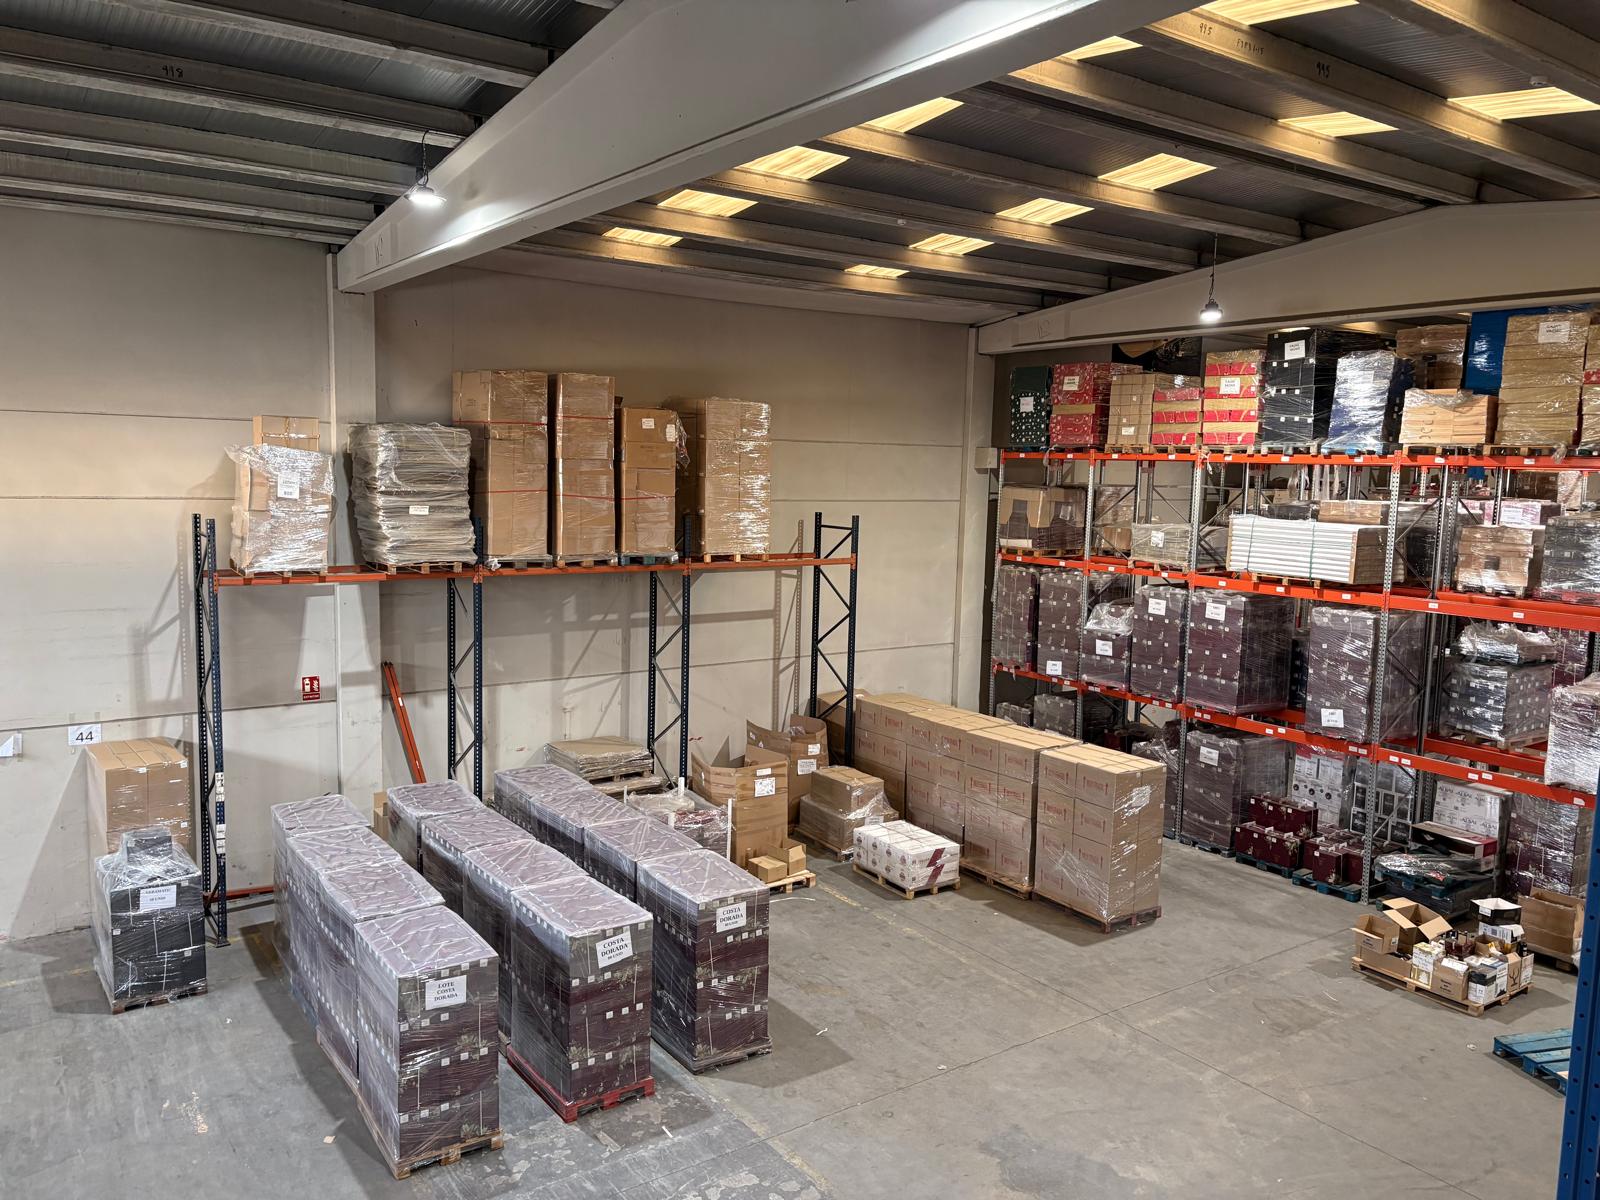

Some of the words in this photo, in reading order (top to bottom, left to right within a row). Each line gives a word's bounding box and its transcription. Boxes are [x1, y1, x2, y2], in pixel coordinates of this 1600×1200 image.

[75, 731, 94, 742] 44
[722, 906, 741, 916] COSTA
[720, 913, 744, 923] DORADA
[603, 937, 625, 949] COSTA
[600, 943, 628, 958] DORADA
[438, 981, 455, 989] LOTE
[437, 987, 456, 995] COSTA
[434, 993, 458, 1002] DORADA
